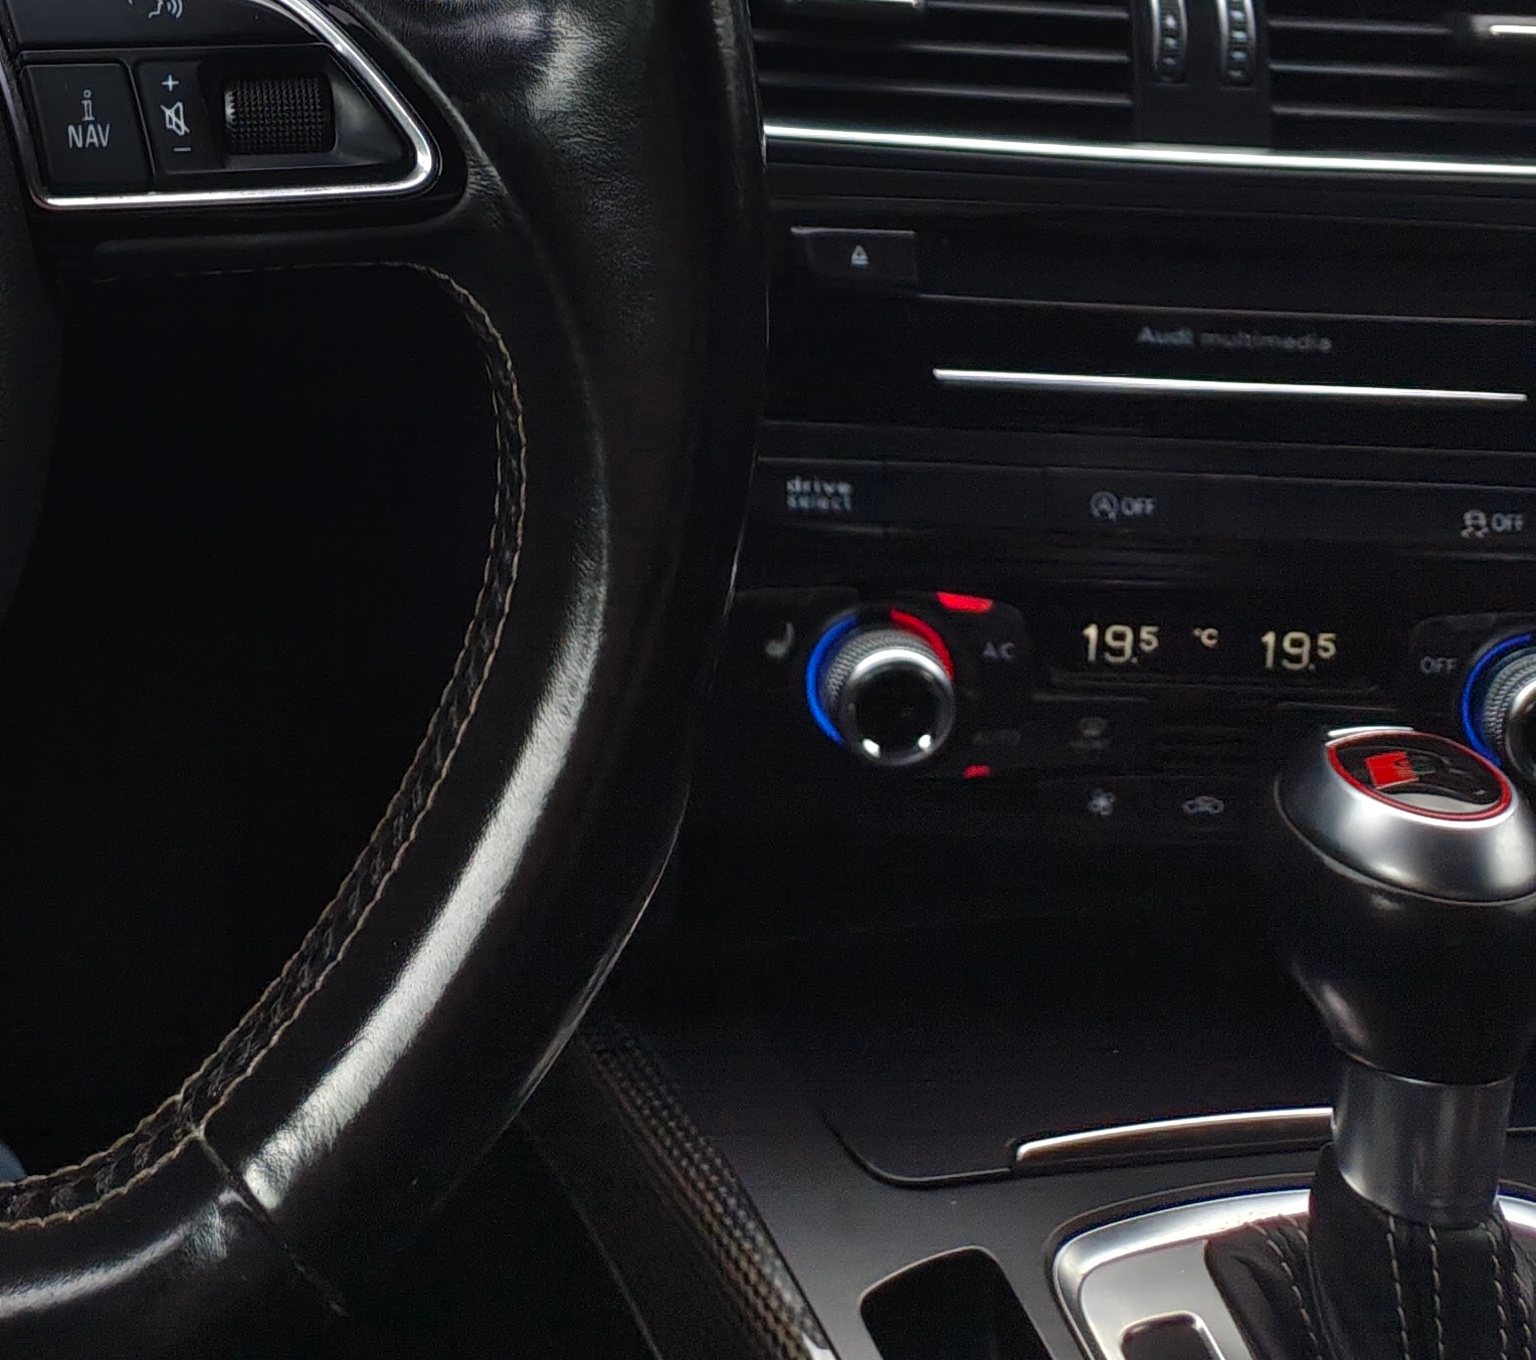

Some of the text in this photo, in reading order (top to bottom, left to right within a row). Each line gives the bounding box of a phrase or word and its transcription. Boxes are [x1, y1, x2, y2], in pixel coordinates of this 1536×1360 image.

[67, 124, 111, 149] NAV
[1121, 497, 1155, 516] OFF
[1420, 656, 1457, 674] OFF
